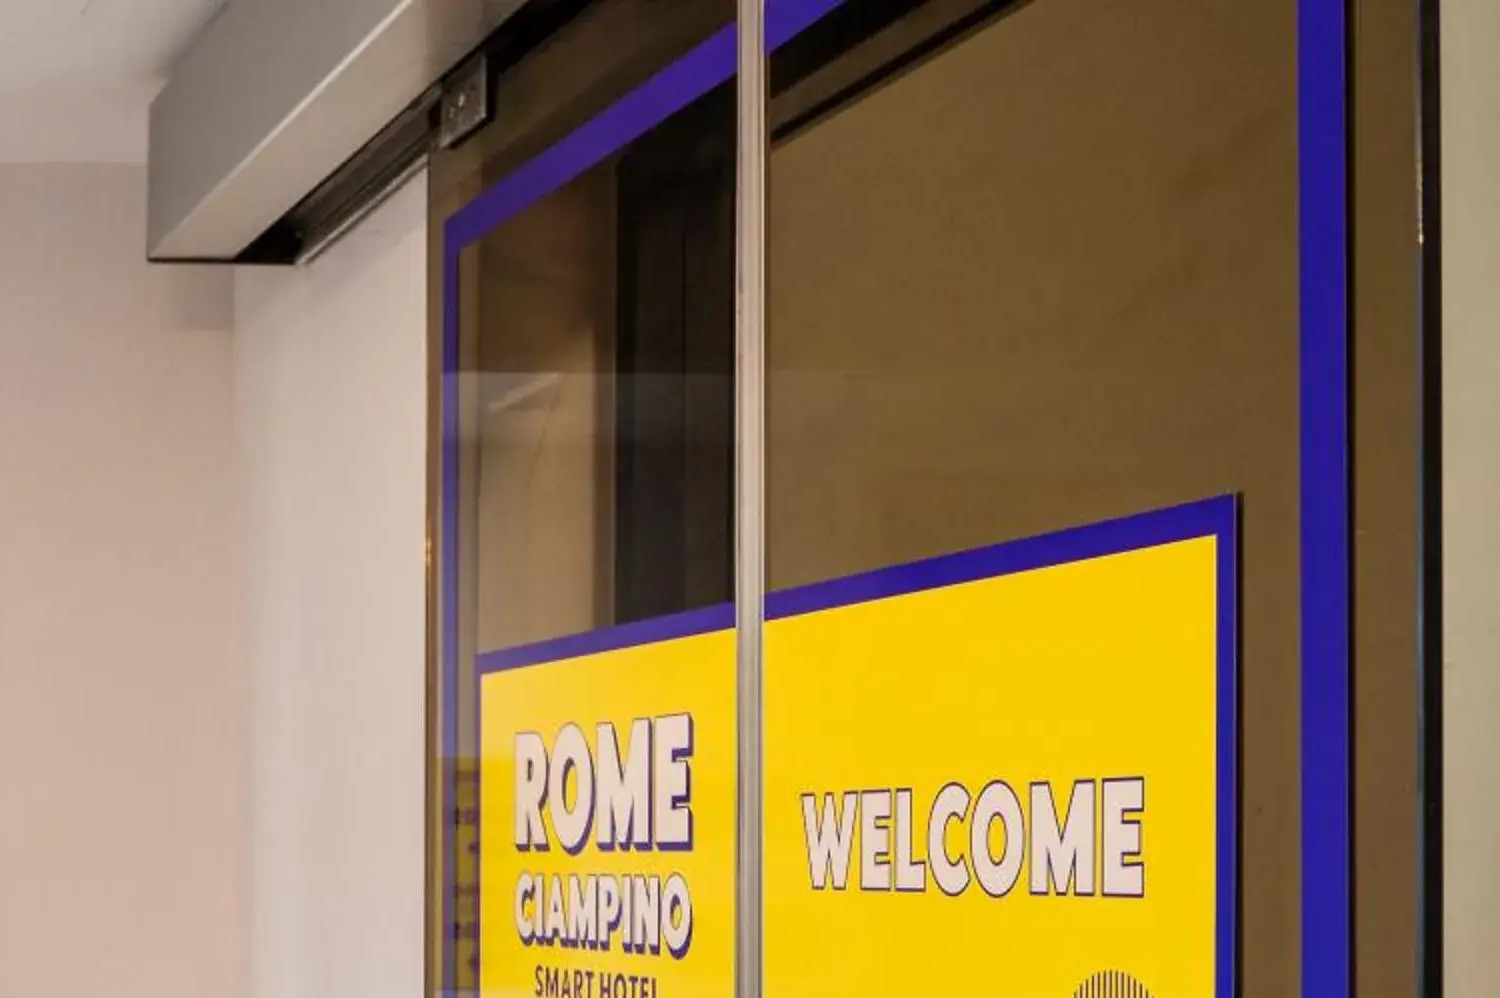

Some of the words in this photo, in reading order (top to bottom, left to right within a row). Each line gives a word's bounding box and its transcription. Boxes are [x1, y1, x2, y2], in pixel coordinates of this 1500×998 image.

[515, 712, 693, 856] ROME
[800, 776, 1145, 898] WELCOME
[515, 870, 693, 960] CIAMPINO
